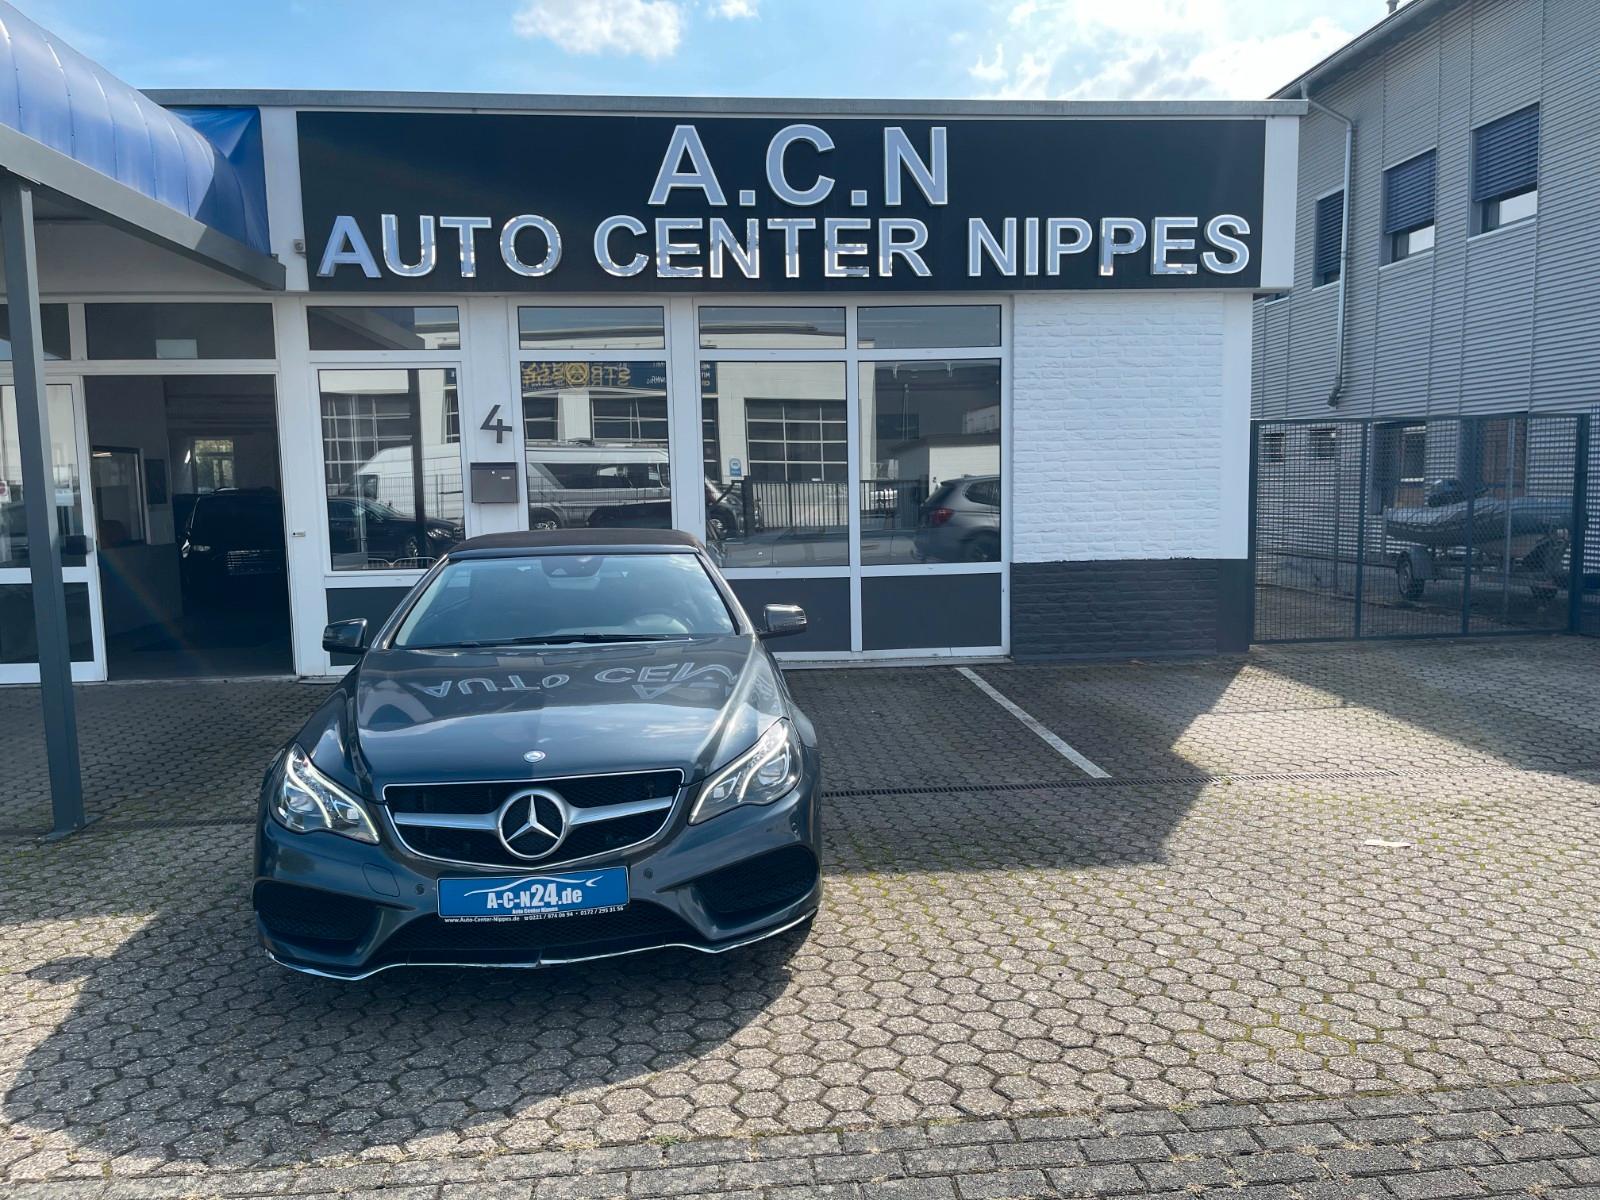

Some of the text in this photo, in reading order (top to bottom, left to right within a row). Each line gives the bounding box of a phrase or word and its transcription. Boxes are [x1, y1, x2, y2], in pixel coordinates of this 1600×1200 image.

[648, 124, 949, 207] A.C.N
[316, 213, 1251, 279] AUTO CENTER NIPPES
[480, 404, 513, 444] 4
[487, 885, 582, 908] A-C-N24.de
